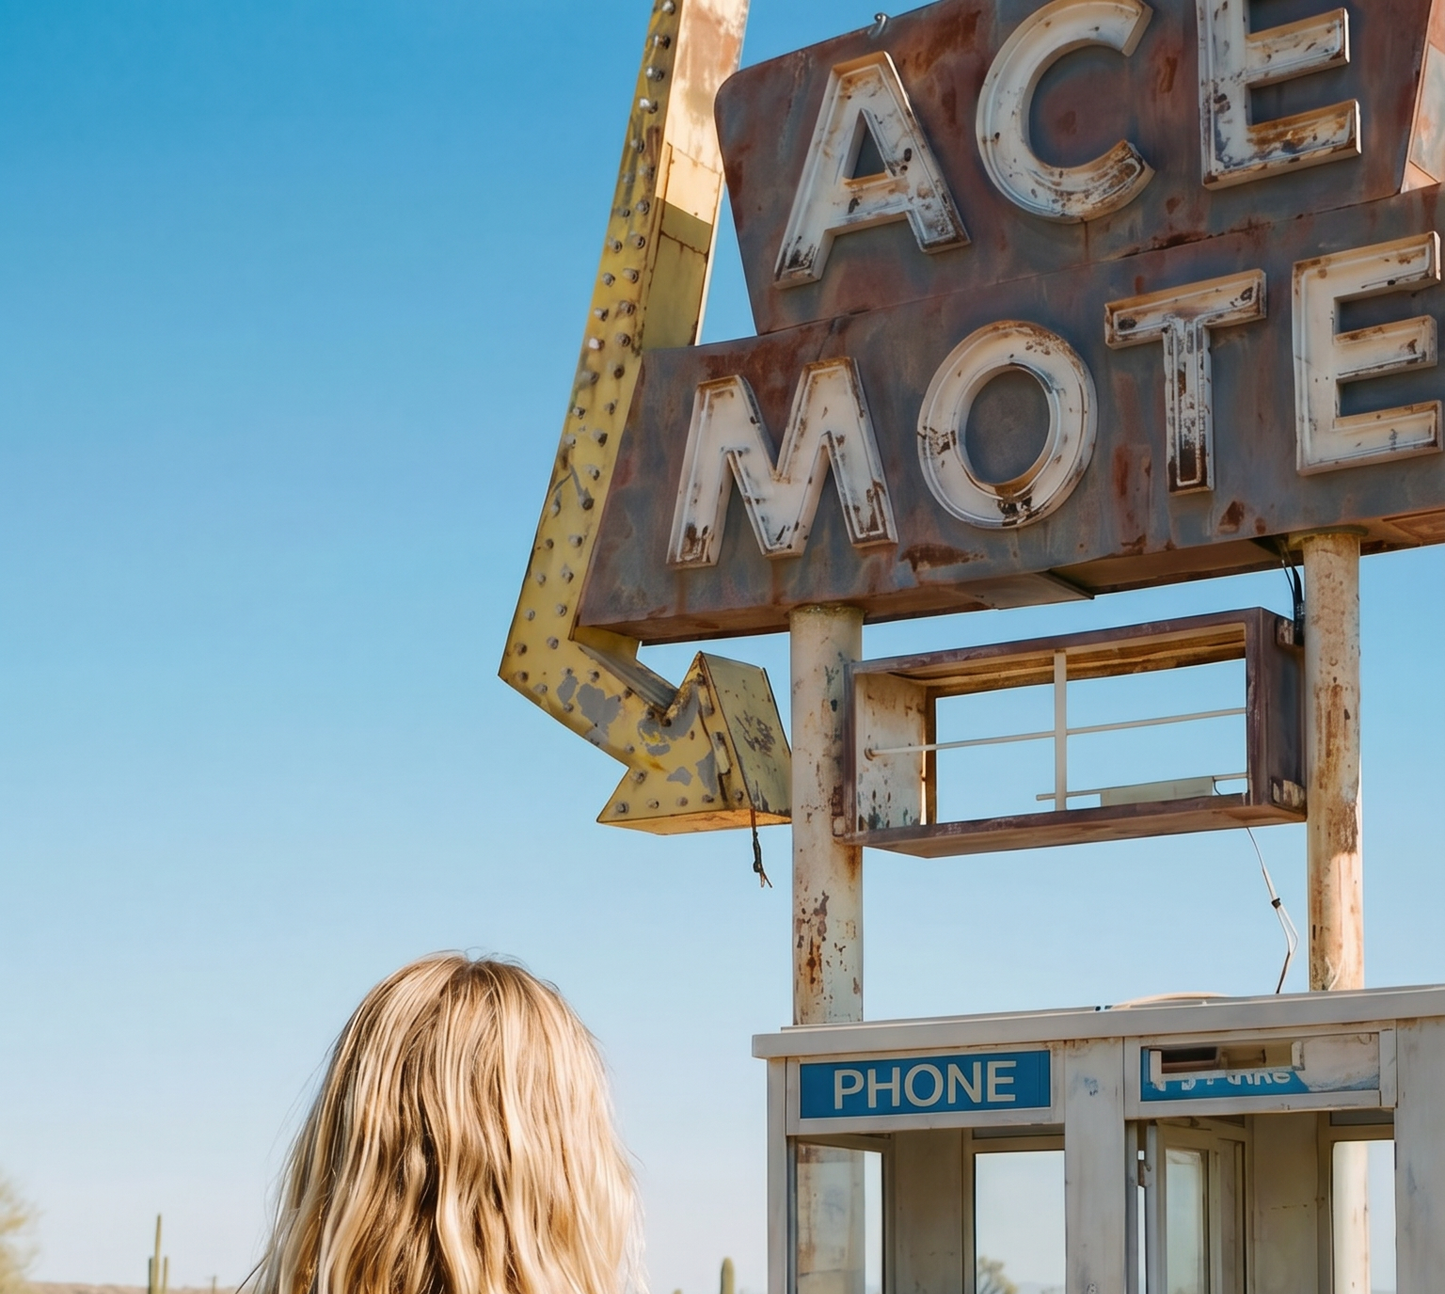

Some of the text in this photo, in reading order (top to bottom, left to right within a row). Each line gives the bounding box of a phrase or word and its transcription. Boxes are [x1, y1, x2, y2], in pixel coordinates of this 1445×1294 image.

[774, 0, 1362, 289] ACE
[666, 231, 1444, 570] MOTE
[832, 1060, 1017, 1110] PHONE
